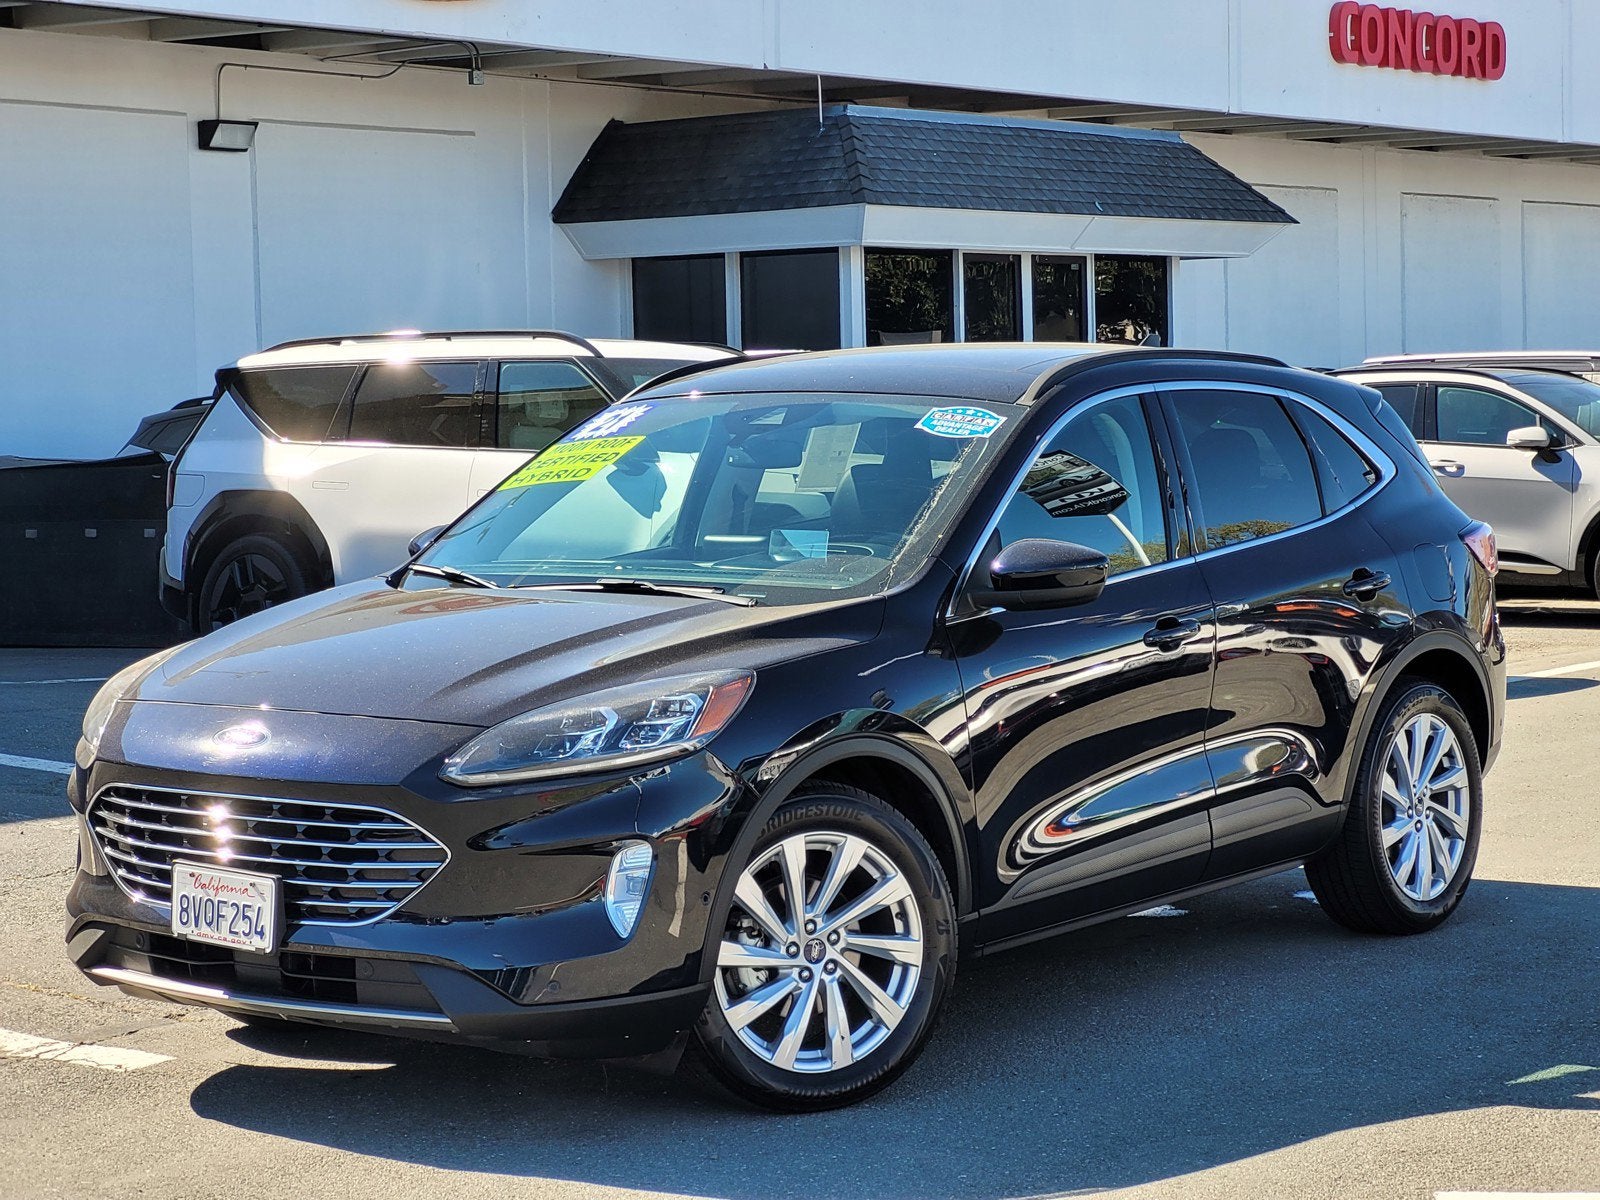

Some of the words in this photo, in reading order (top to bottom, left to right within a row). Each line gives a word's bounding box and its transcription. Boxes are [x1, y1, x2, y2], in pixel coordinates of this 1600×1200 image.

[1329, 1, 1506, 81] CONCORD
[930, 419, 986, 432] ADVANTAGE
[934, 426, 971, 436] DEALER
[525, 451, 620, 471] CERTIFIED
[508, 467, 593, 486] HYBRID
[193, 873, 256, 898] California
[179, 893, 266, 941] 8VQF254
[196, 931, 248, 944] dmv.ca.gov
